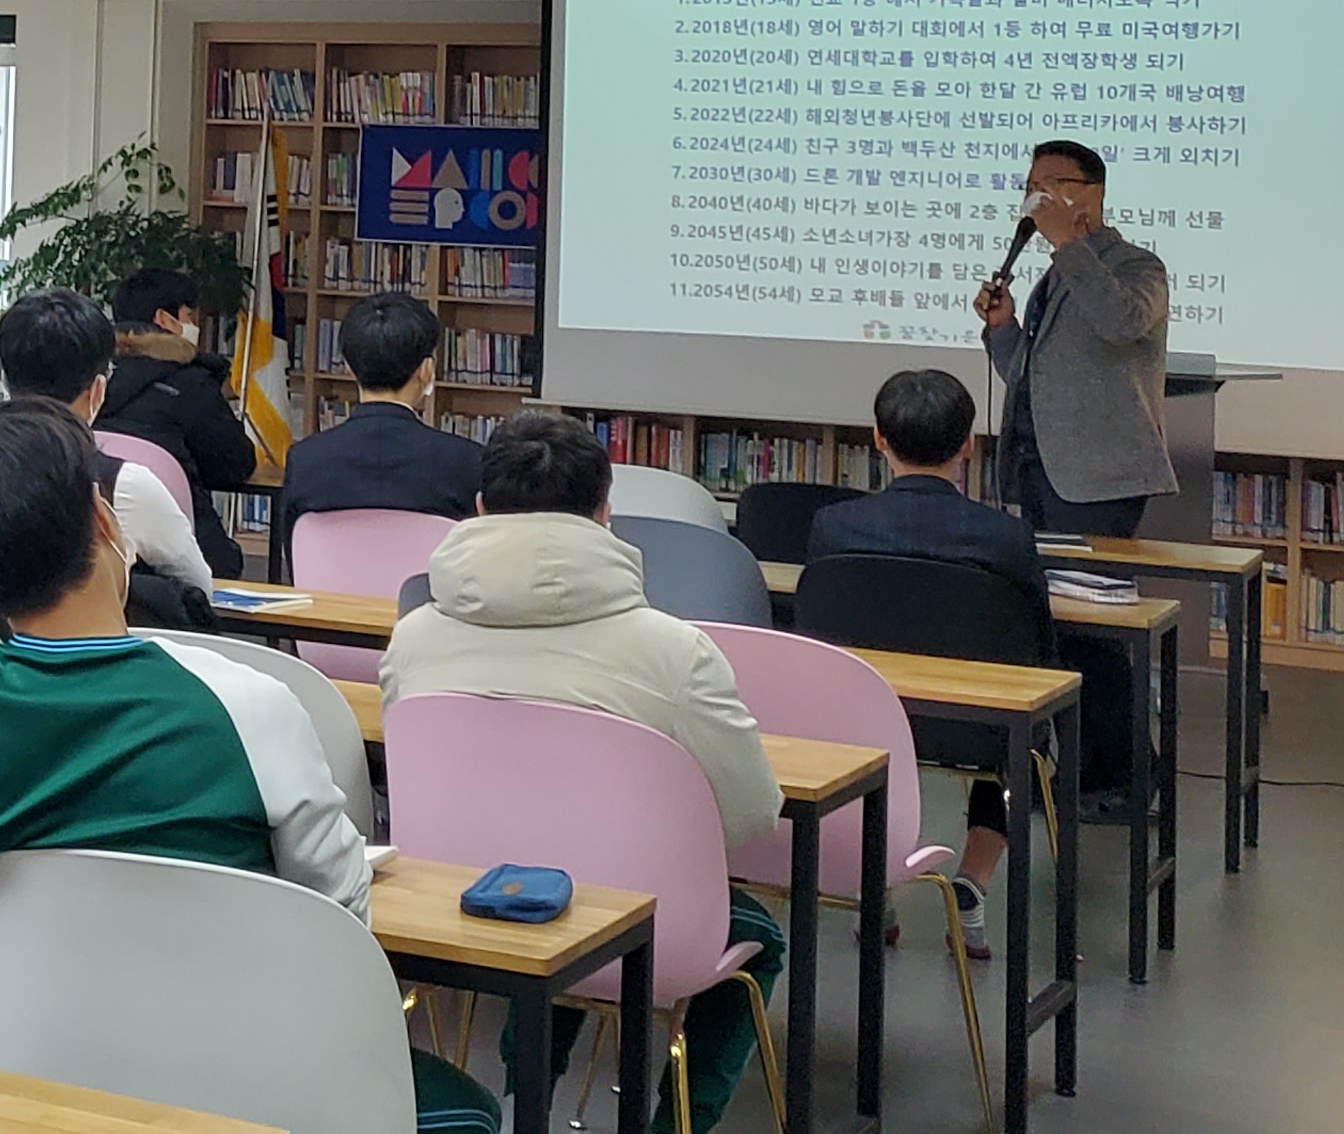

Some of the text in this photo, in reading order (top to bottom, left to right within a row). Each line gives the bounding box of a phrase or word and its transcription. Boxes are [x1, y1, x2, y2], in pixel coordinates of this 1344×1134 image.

[808, 19, 841, 36] 영어
[851, 20, 902, 37] 말하기
[912, 20, 984, 38] 대회에서
[994, 21, 1021, 38] 1등
[1030, 21, 1066, 39] 하여
[1075, 21, 1112, 38] 무료
[1123, 22, 1239, 40] 미국여행가기
[808, 50, 914, 67] 연세대학교를
[924, 51, 995, 69] 입학하여
[1004, 52, 1032, 69] 4년
[1042, 52, 1137, 70] 전액장학생
[1146, 53, 1183, 71] 되기
[807, 79, 822, 95] 내
[831, 79, 883, 95] 힘으로
[892, 80, 926, 97] 돈을
[935, 82, 971, 98] 모아
[980, 82, 1016, 99] 한달
[1025, 82, 1042, 99] 간
[1050, 83, 1086, 100] 유럽
[1098, 84, 1157, 102] 10개국
[1166, 85, 1244, 103] 배낭여행
[806, 108, 950, 128] 해외청년봉사단에
[960, 112, 1032, 130] 선발되어
[1043, 114, 1156, 133] 아프리카에서
[1167, 116, 1245, 135] 봉사하기
[806, 138, 839, 155] 친구
[847, 139, 893, 157] 3명과
[902, 140, 955, 158] 백두산
[1133, 147, 1170, 163] 크게
[1180, 147, 1238, 166] 외치기
[804, 168, 839, 185] 드론
[847, 169, 881, 186] 개발
[890, 170, 981, 188] 엔지니어로
[805, 198, 856, 216] 바다가
[864, 200, 918, 218] 보이는
[926, 201, 961, 219] 곳에
[970, 204, 998, 220] 2층
[1186, 211, 1224, 229] 선물
[803, 228, 911, 248] 소년소녀가장
[919, 233, 984, 250] 4명에게
[811, 257, 825, 274] 내
[835, 258, 943, 279] 인생이야기를
[953, 263, 988, 282] 담은
[1186, 274, 1224, 293] 되기
[809, 288, 843, 303] 모교
[852, 289, 904, 307] 후배들
[914, 292, 967, 312] 앞에서
